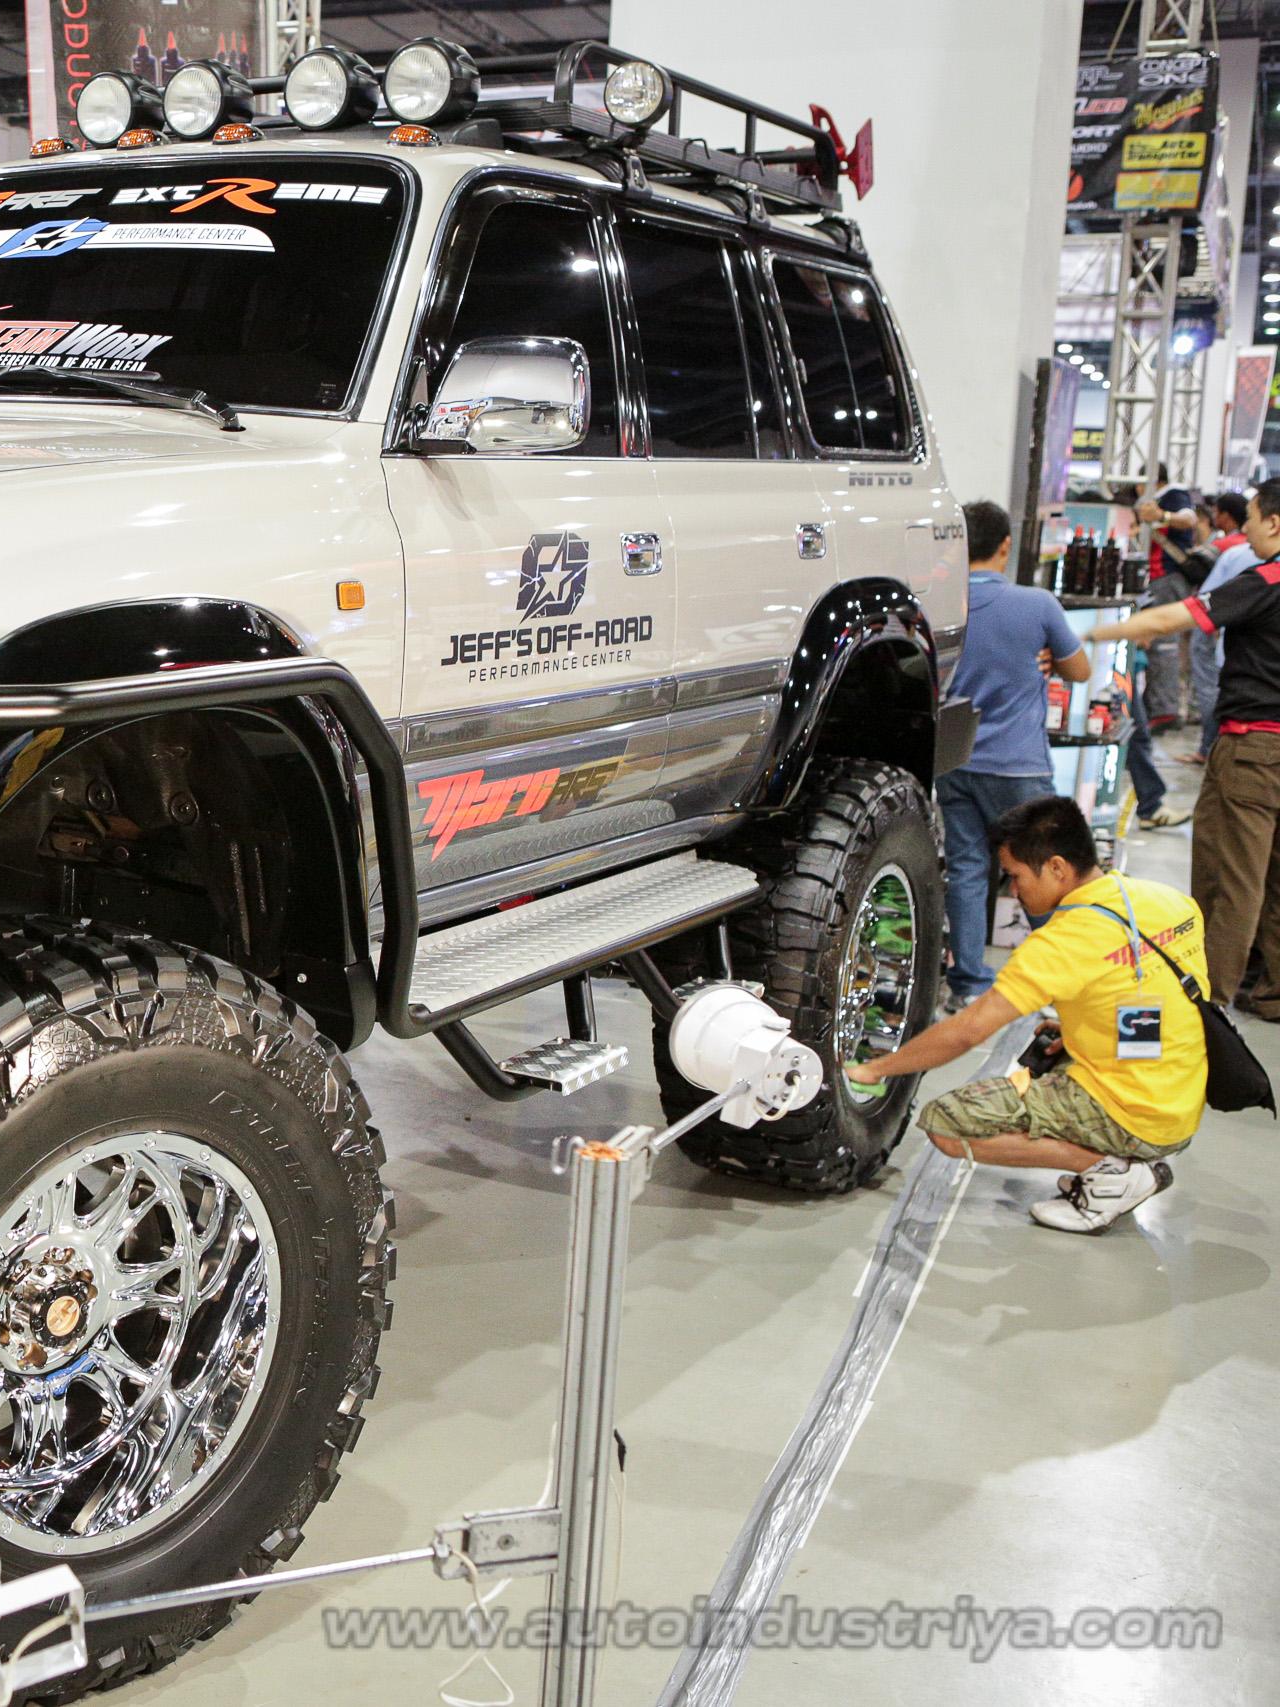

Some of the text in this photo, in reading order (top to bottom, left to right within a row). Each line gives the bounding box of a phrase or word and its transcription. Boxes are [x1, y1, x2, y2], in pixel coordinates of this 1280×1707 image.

[1139, 57, 1208, 74] CONCEPT
[1138, 73, 1208, 86] ONE
[111, 227, 247, 241] PERFORMANCE CENTER
[62, 356, 80, 368] OF
[849, 472, 913, 487] NITTO
[440, 615, 653, 666] JEFF'S OFF-ROAD
[468, 649, 633, 683] PERFORMANCE CENTER
